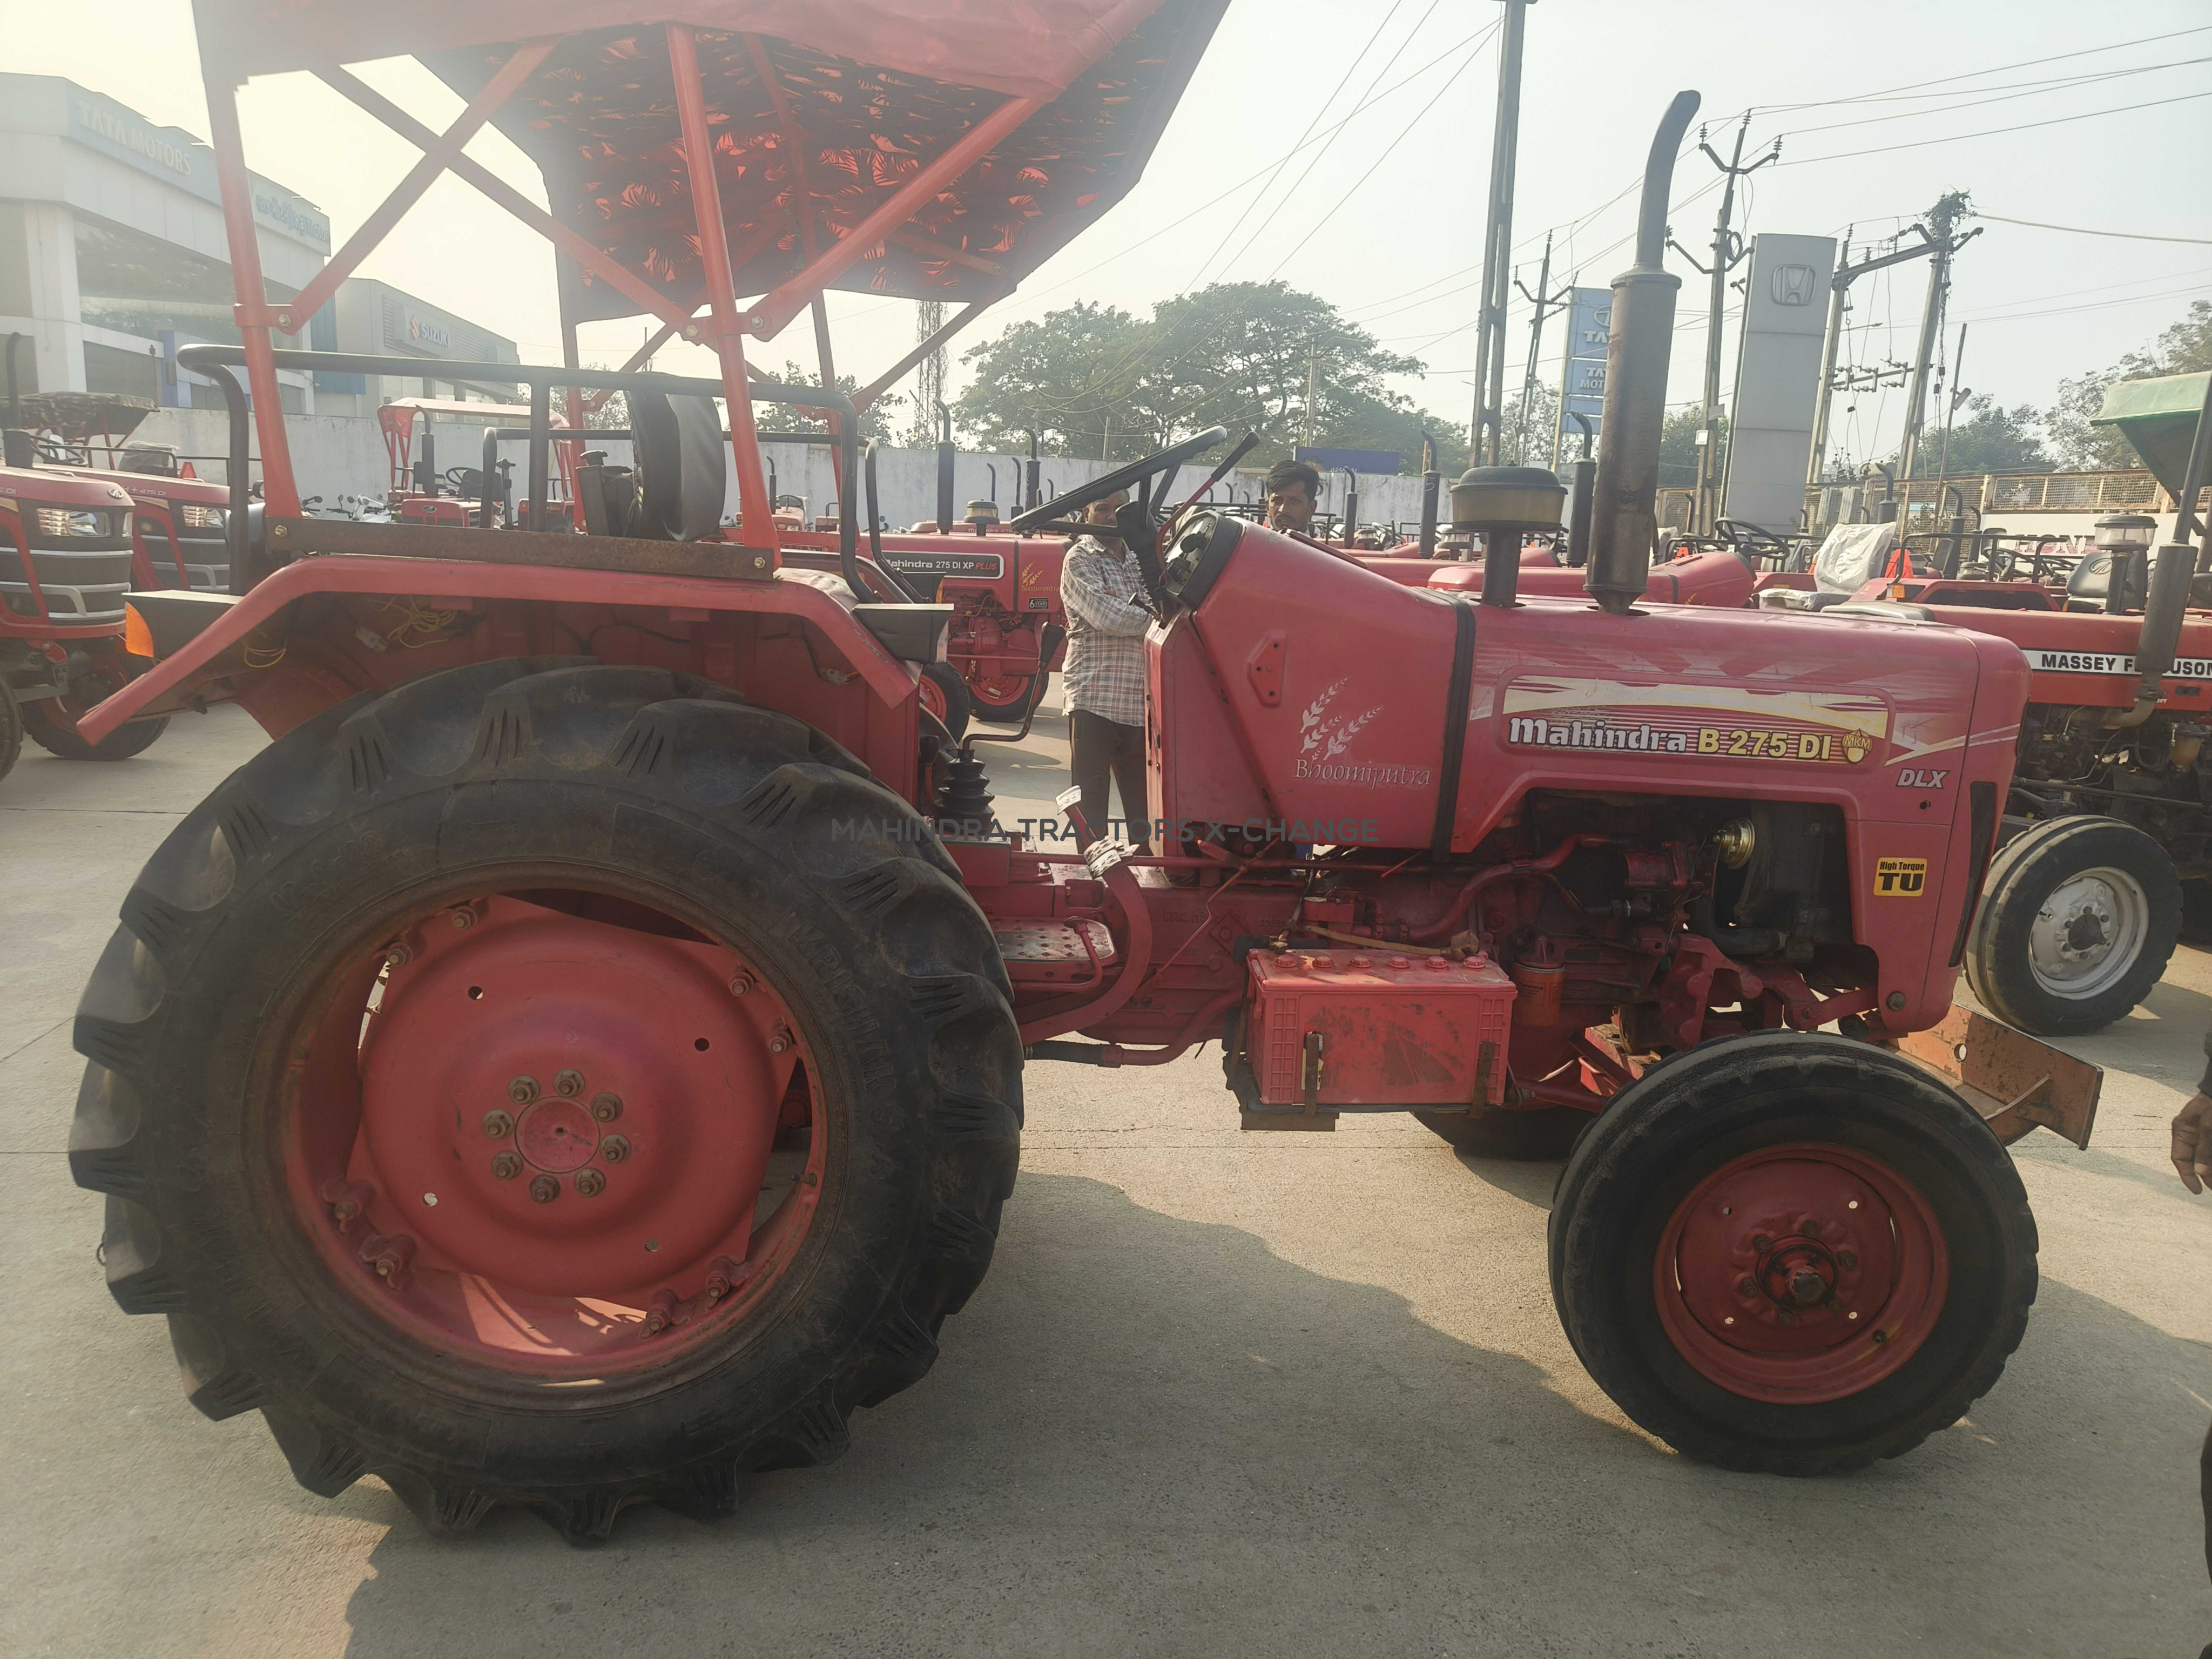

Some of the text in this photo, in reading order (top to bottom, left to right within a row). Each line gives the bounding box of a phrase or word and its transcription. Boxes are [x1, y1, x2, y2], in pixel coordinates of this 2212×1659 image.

[77, 99, 191, 176] TATA MOTORS
[421, 323, 450, 347] SUZUKI
[1584, 330, 1609, 343] TA
[1587, 367, 1606, 377] TA
[1580, 380, 1604, 389] MOT
[935, 561, 950, 569] 275
[975, 562, 997, 570] PLUS
[1029, 599, 1035, 608] 6
[2041, 654, 2212, 676] MASSEY FUSO
[1509, 717, 1832, 760] Mahindra B 275 DI
[1844, 734, 1871, 750] MKM
[1294, 758, 1431, 791] Bhoomiputra
[1897, 768, 1950, 788] DLX
[1879, 861, 1925, 871] High Torque
[1878, 873, 1924, 891] TU
